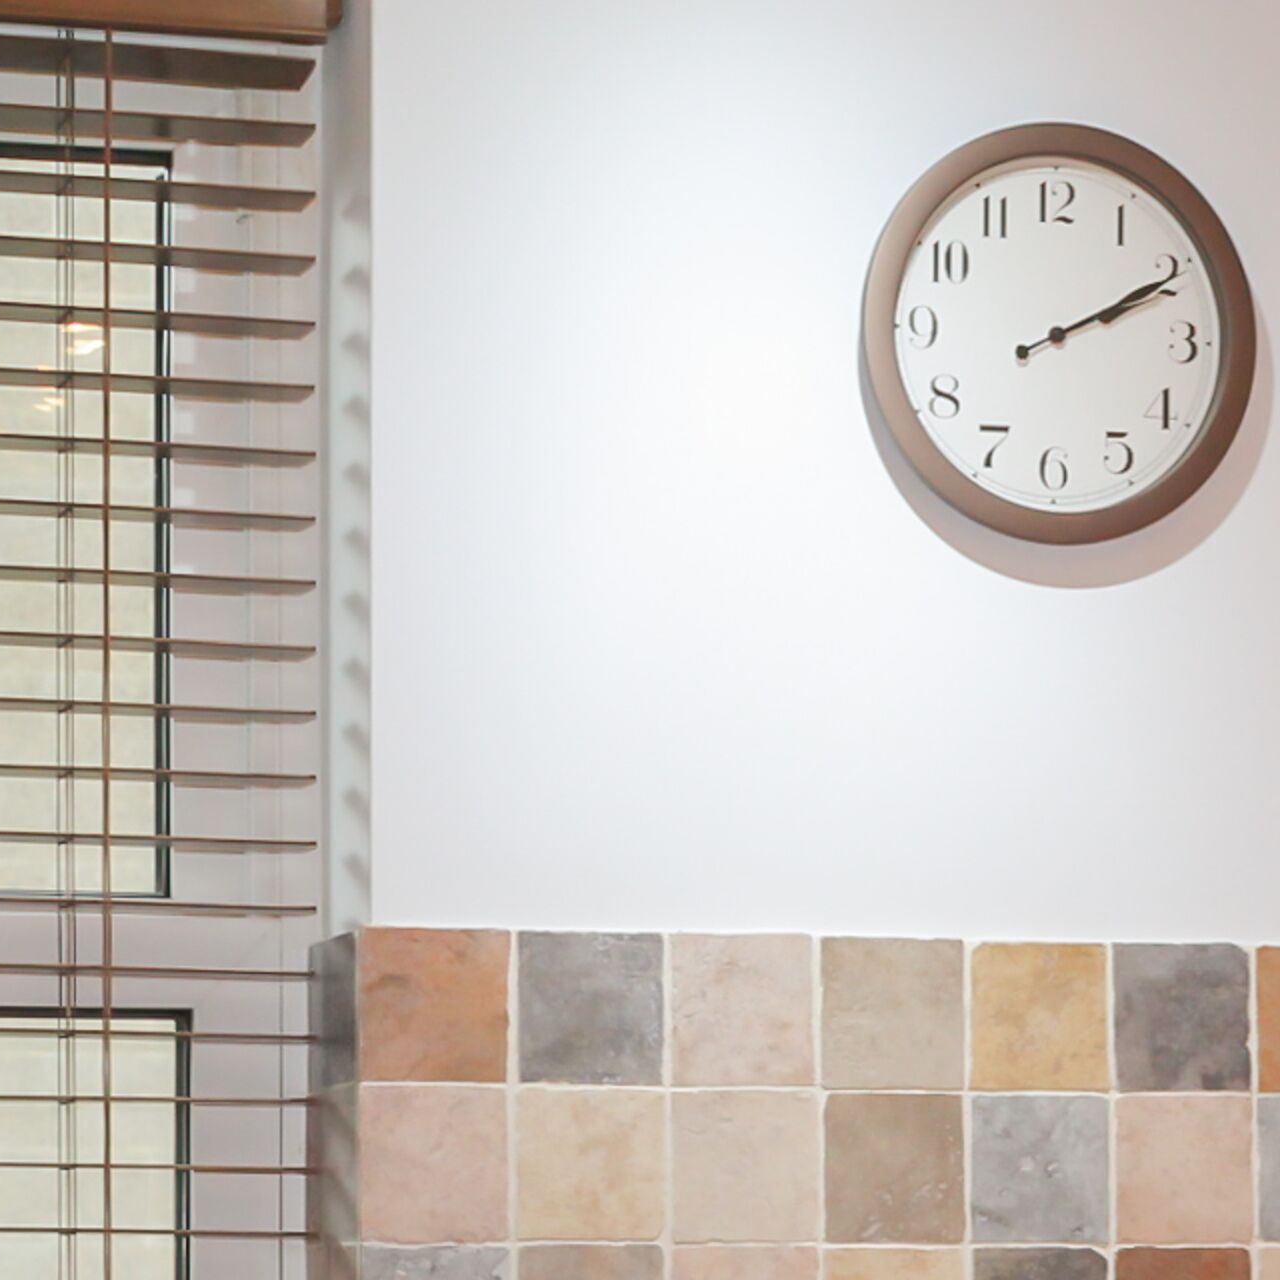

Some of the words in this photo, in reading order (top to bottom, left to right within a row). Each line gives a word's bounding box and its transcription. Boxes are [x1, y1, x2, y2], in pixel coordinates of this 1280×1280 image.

[981, 195, 1008, 239] 11
[1037, 180, 1076, 225] 12
[1116, 203, 1125, 247] 1
[930, 239, 970, 285] 10
[1155, 253, 1179, 297] 2
[907, 305, 939, 350] 9
[1167, 320, 1199, 365] 3
[928, 374, 961, 419] 8
[1143, 387, 1178, 431] 4
[978, 424, 1011, 470] 7
[1038, 446, 1069, 491] 6
[1103, 431, 1135, 475] 5
